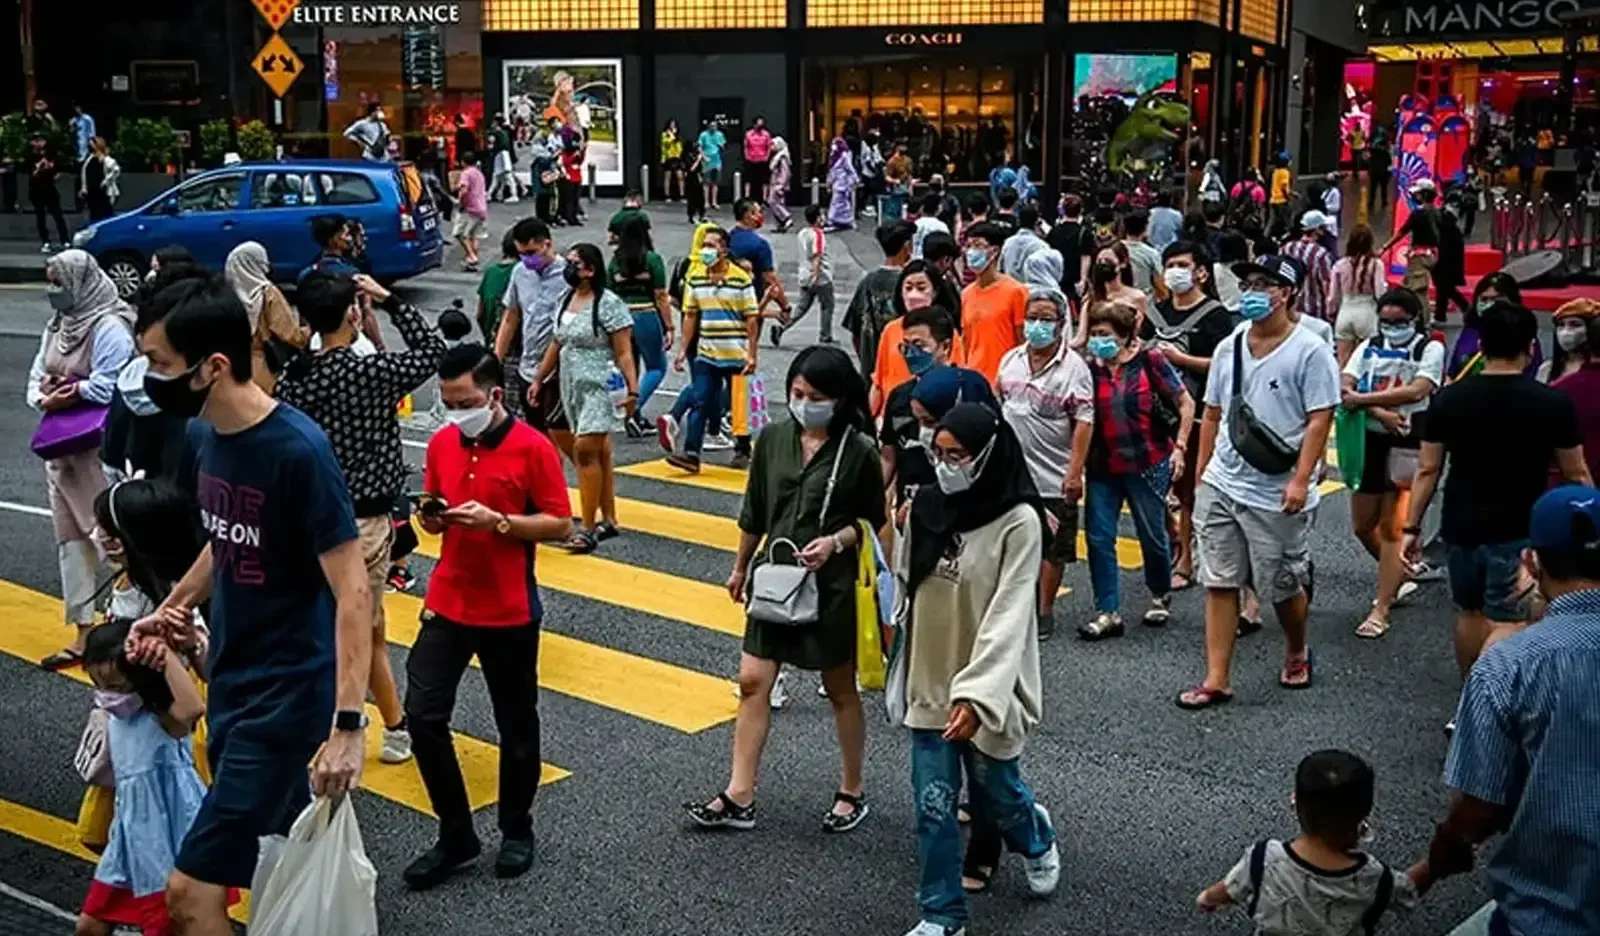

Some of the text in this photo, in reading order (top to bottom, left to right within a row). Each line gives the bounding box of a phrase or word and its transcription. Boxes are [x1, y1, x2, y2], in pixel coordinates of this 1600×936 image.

[293, 4, 460, 23] ELITE ENTRANCE
[1405, 0, 1580, 33] MANGO
[885, 32, 962, 45] COACH
